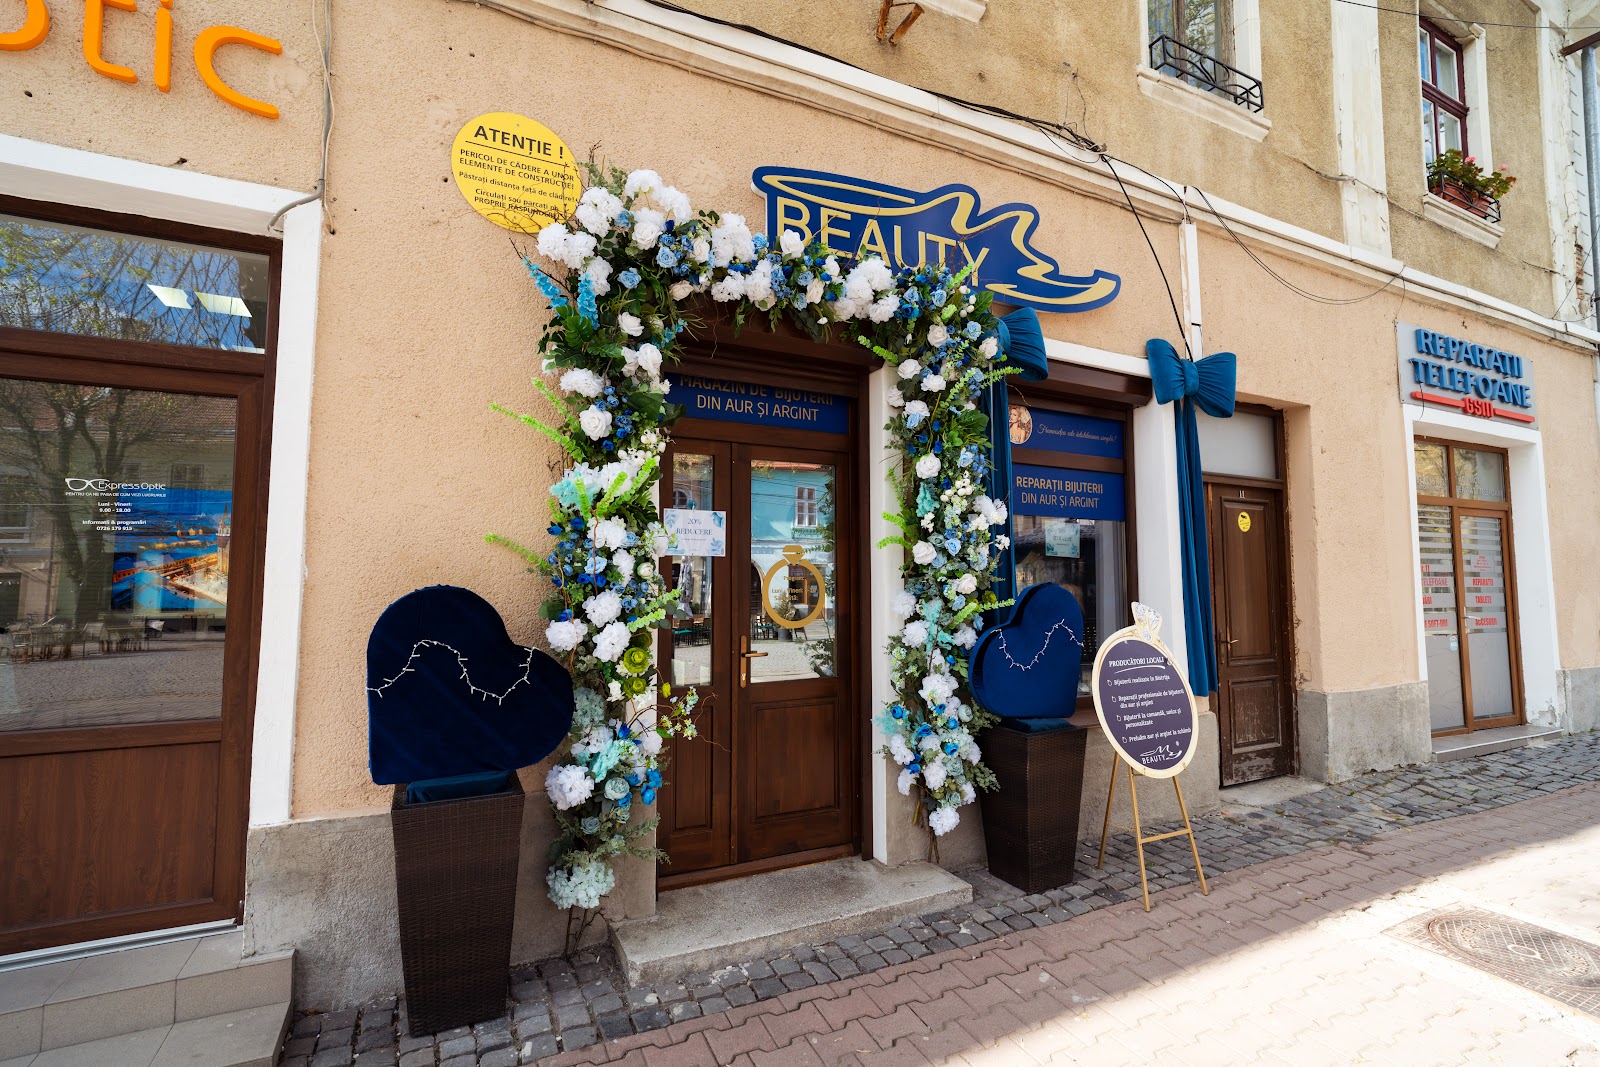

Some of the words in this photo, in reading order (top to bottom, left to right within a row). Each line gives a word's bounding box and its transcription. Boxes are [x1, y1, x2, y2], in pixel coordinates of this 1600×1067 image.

[474, 125, 552, 156] ATENȚIE
[559, 146, 564, 159] !
[459, 158, 503, 174] ELEMENTE
[505, 168, 516, 177] DE
[460, 149, 494, 163] PERICOL
[496, 157, 508, 166] DE
[509, 160, 541, 174] CĂDERE
[551, 171, 574, 181] UNOR
[459, 171, 488, 184] Păstrați
[489, 178, 520, 191] distanța
[522, 185, 537, 195] față
[538, 189, 548, 197] de
[474, 196, 507, 209] PROPRIE
[475, 188, 507, 202] Circulați
[508, 196, 522, 204] sau
[777, 196, 990, 287] BEAUTY
[680, 375, 746, 395] MAGAZIN
[750, 383, 768, 397] DE
[1409, 357, 1532, 408] TELEFOANE
[697, 394, 721, 411] DIN
[725, 398, 754, 414] AUR
[757, 402, 769, 418] ȘI
[772, 405, 820, 421] ARGINT
[1462, 397, 1494, 418] GSM
[98, 480, 140, 491] Express
[140, 482, 166, 491] Optic
[1016, 476, 1062, 492] REPARAȚII
[1065, 481, 1103, 494] BIJUTERII
[1239, 490, 1245, 498] 11
[1021, 492, 1037, 504] DIN
[1039, 493, 1057, 505] AUR
[1059, 495, 1067, 508] ȘI
[1069, 496, 1099, 508] ARGINT
[675, 527, 713, 536] REDUCERE
[1109, 657, 1146, 667] PRODUCĂTORI
[1146, 656, 1165, 664] LOCALI
[1142, 754, 1166, 764] BEAUTY
